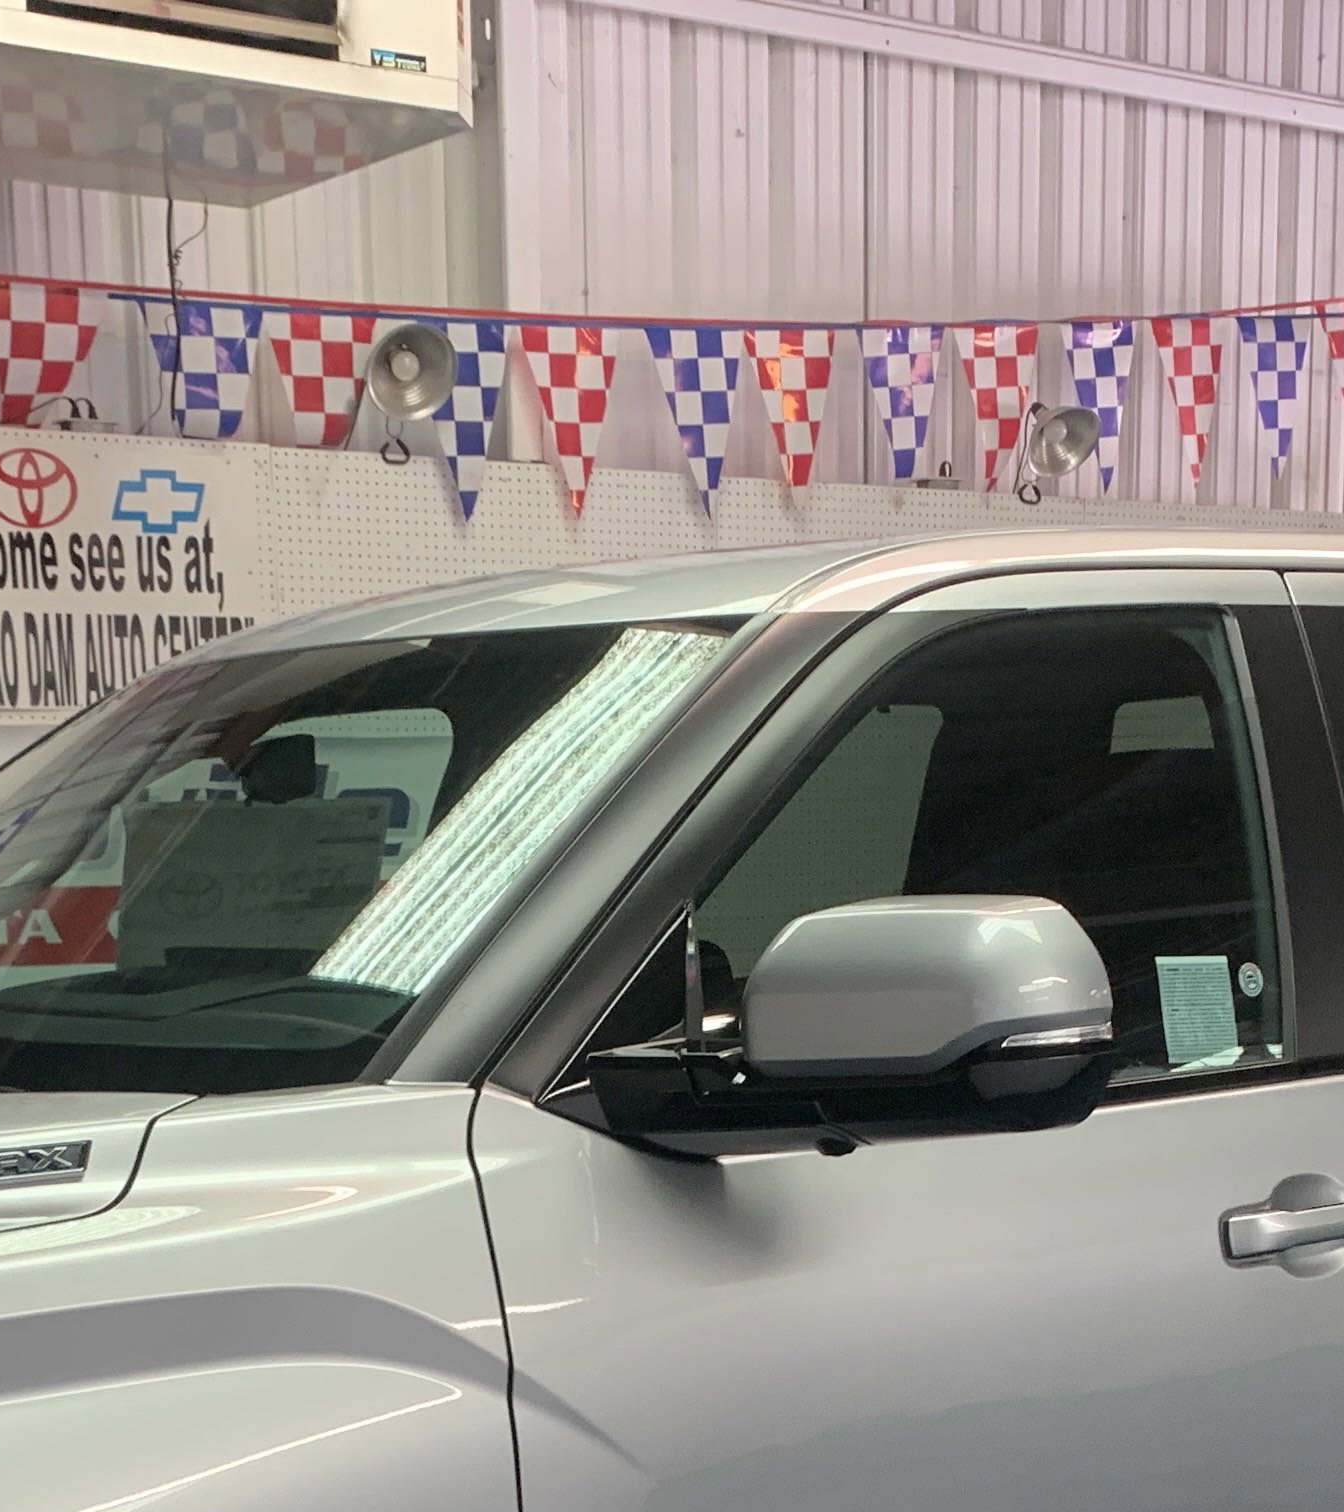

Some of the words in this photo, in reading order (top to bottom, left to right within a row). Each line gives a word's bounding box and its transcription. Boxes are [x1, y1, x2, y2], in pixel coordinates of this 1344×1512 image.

[68, 532, 126, 592] see
[136, 535, 173, 593] us
[184, 518, 224, 612] at,
[23, 611, 78, 706] DAM
[85, 613, 147, 706] AUTO
